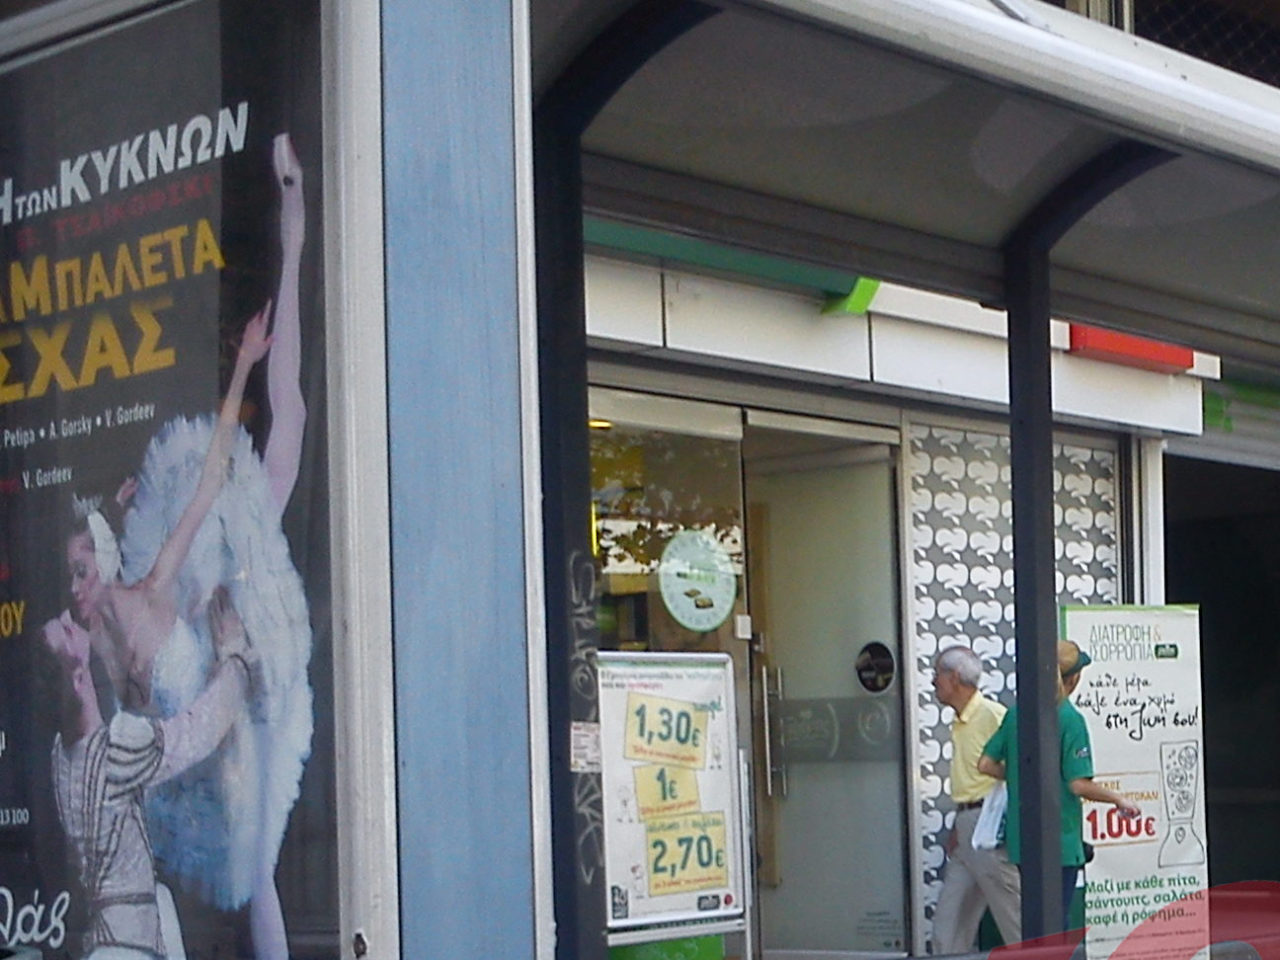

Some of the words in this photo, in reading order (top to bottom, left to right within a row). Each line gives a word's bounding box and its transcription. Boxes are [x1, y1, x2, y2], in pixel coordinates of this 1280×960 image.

[59, 101, 249, 207] ΚΥΚΝΩΝ
[3, 427, 36, 449] Petipa
[61, 415, 92, 436] Gorsky
[117, 402, 156, 426] Gordeev
[36, 465, 73, 488] Gordeev
[1089, 624, 1151, 643] ΔΙΑΤΡΟΦΗ
[1089, 642, 1154, 662] ΙΣΟΡΡΟΠΙΑ
[635, 703, 701, 747] 1,30€
[656, 767, 678, 801] 1€
[652, 834, 725, 878] 2,70€
[1117, 880, 1132, 893] με
[1134, 875, 1165, 890] κάθε
[1168, 873, 1200, 887] πίτα,
[1086, 912, 1118, 928] καφέ
[1121, 911, 1129, 925] ή
